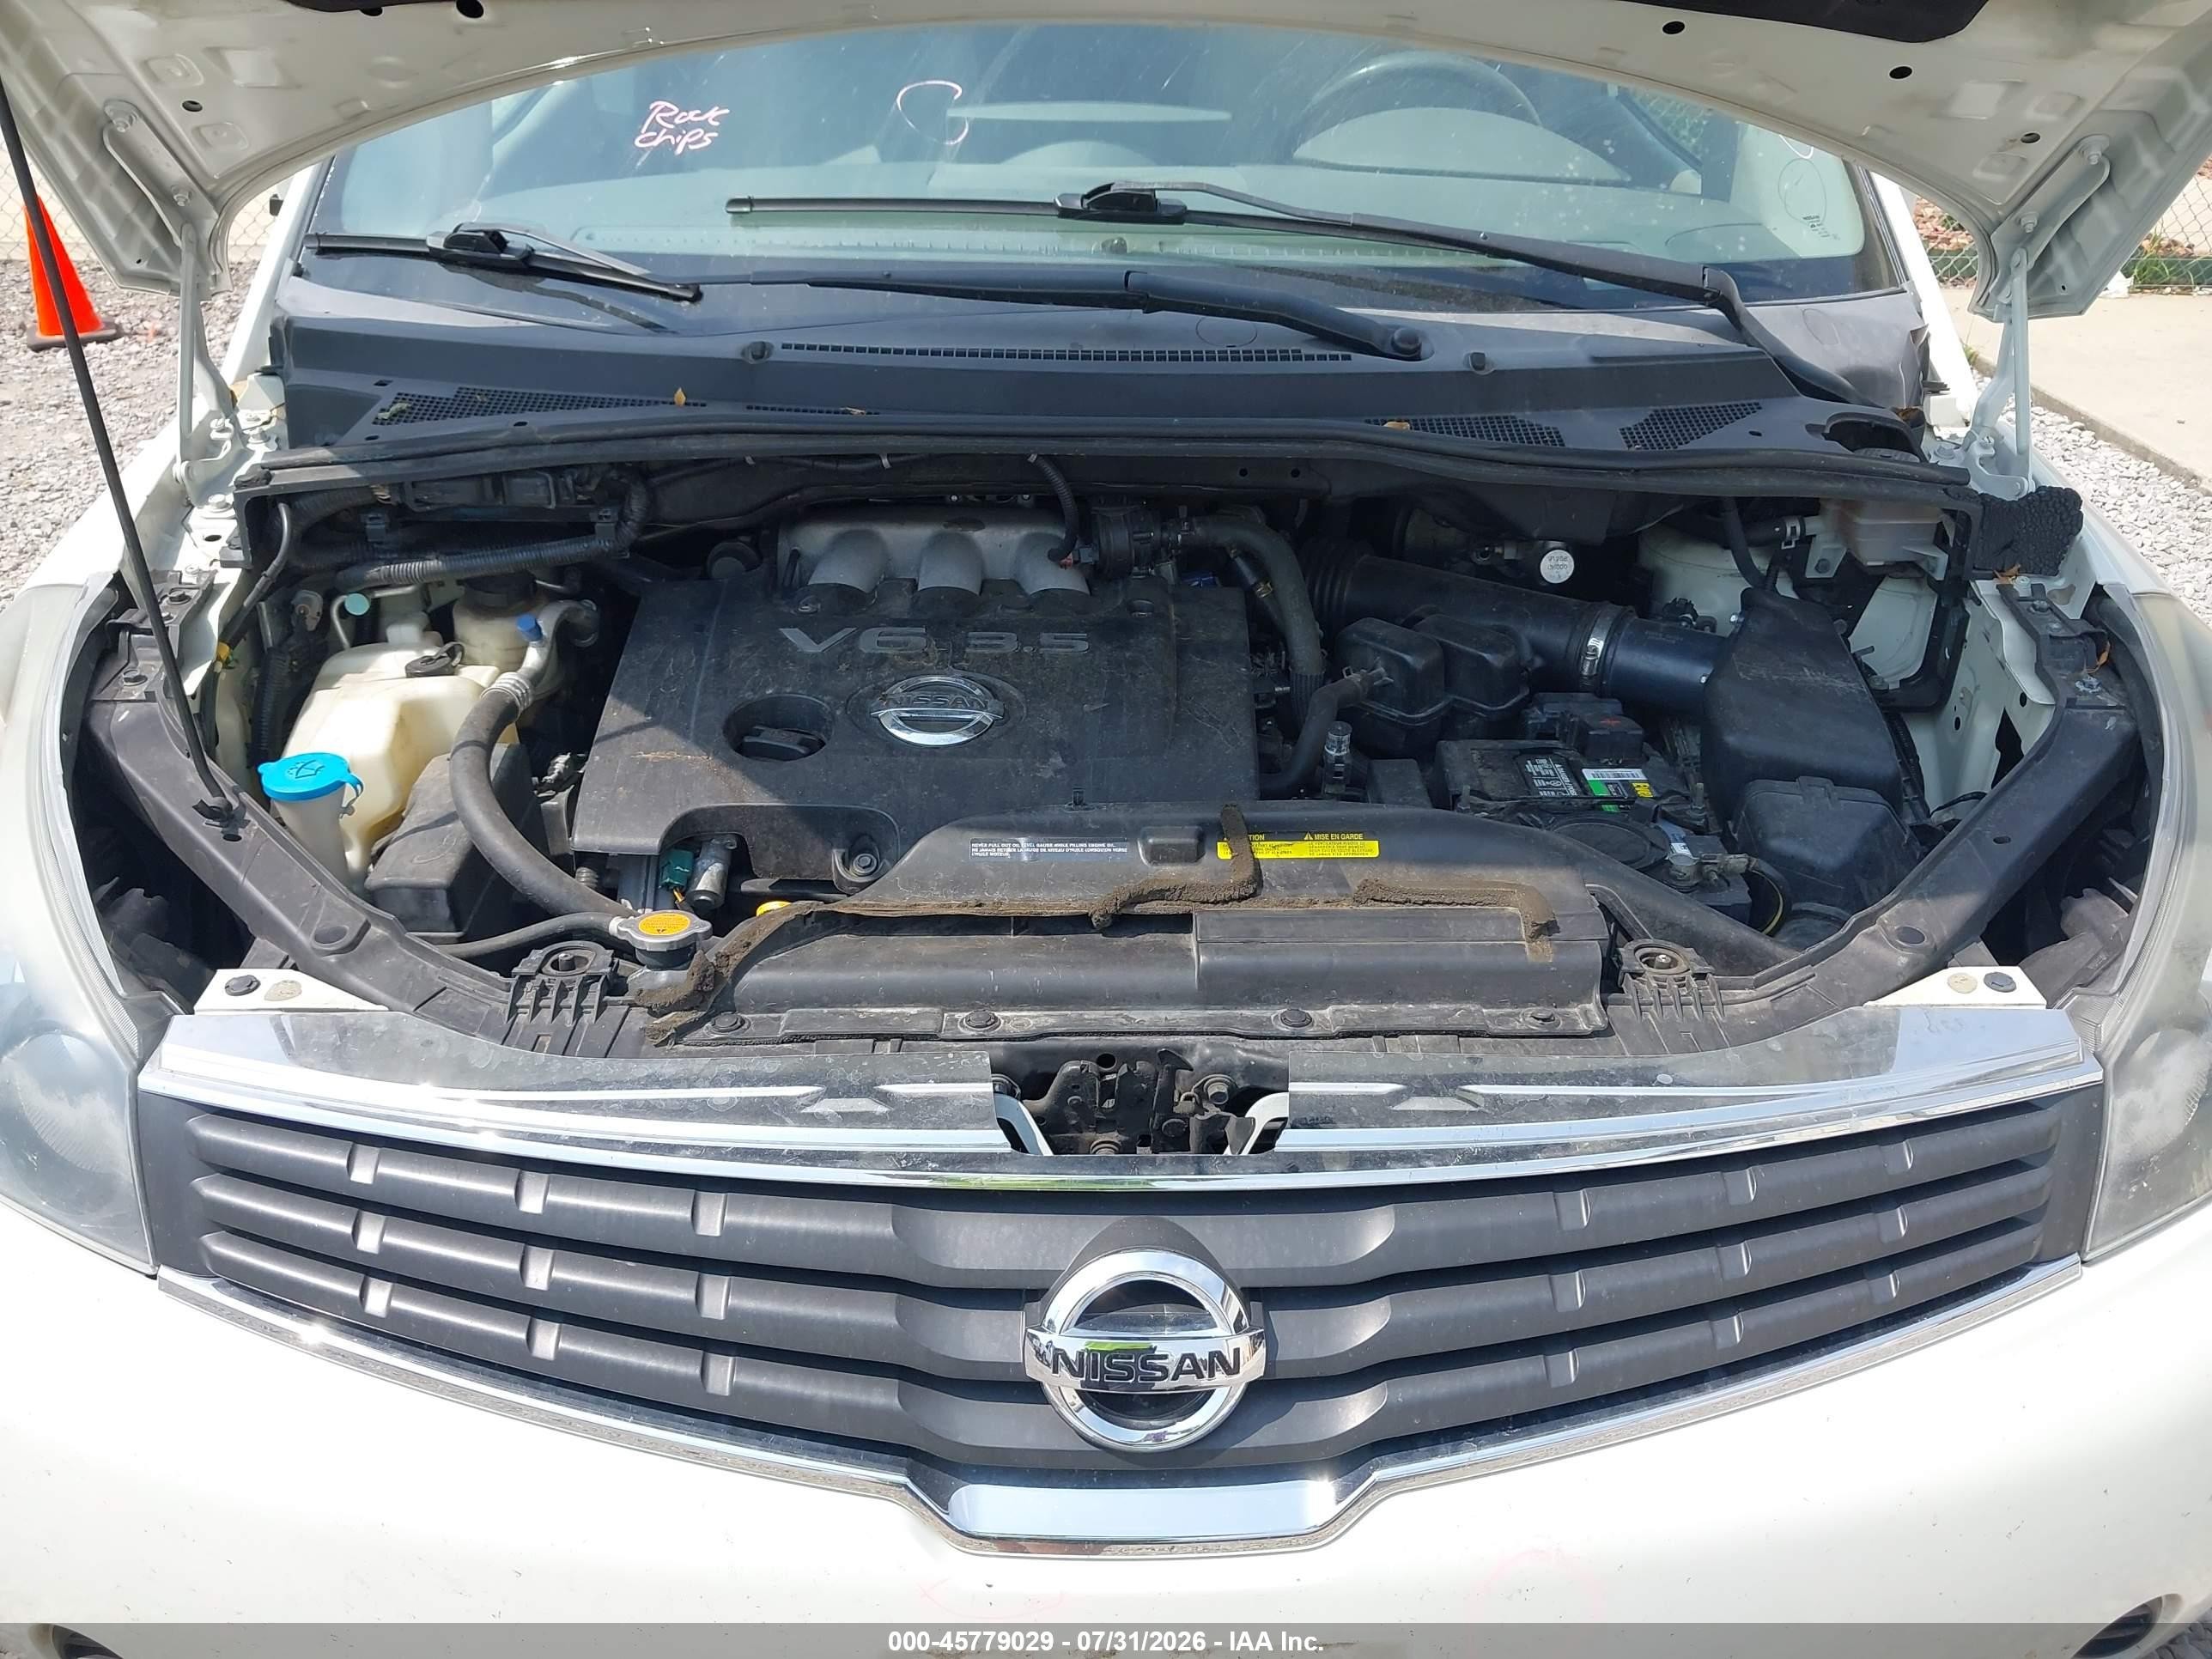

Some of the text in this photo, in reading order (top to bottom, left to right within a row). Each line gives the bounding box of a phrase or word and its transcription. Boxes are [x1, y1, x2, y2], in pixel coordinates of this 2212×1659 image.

[641, 100, 731, 134] Rock
[778, 626, 1090, 653] V6 3.5
[886, 692, 989, 709] NISSAN
[1052, 1346, 1241, 1383] NISSAN
